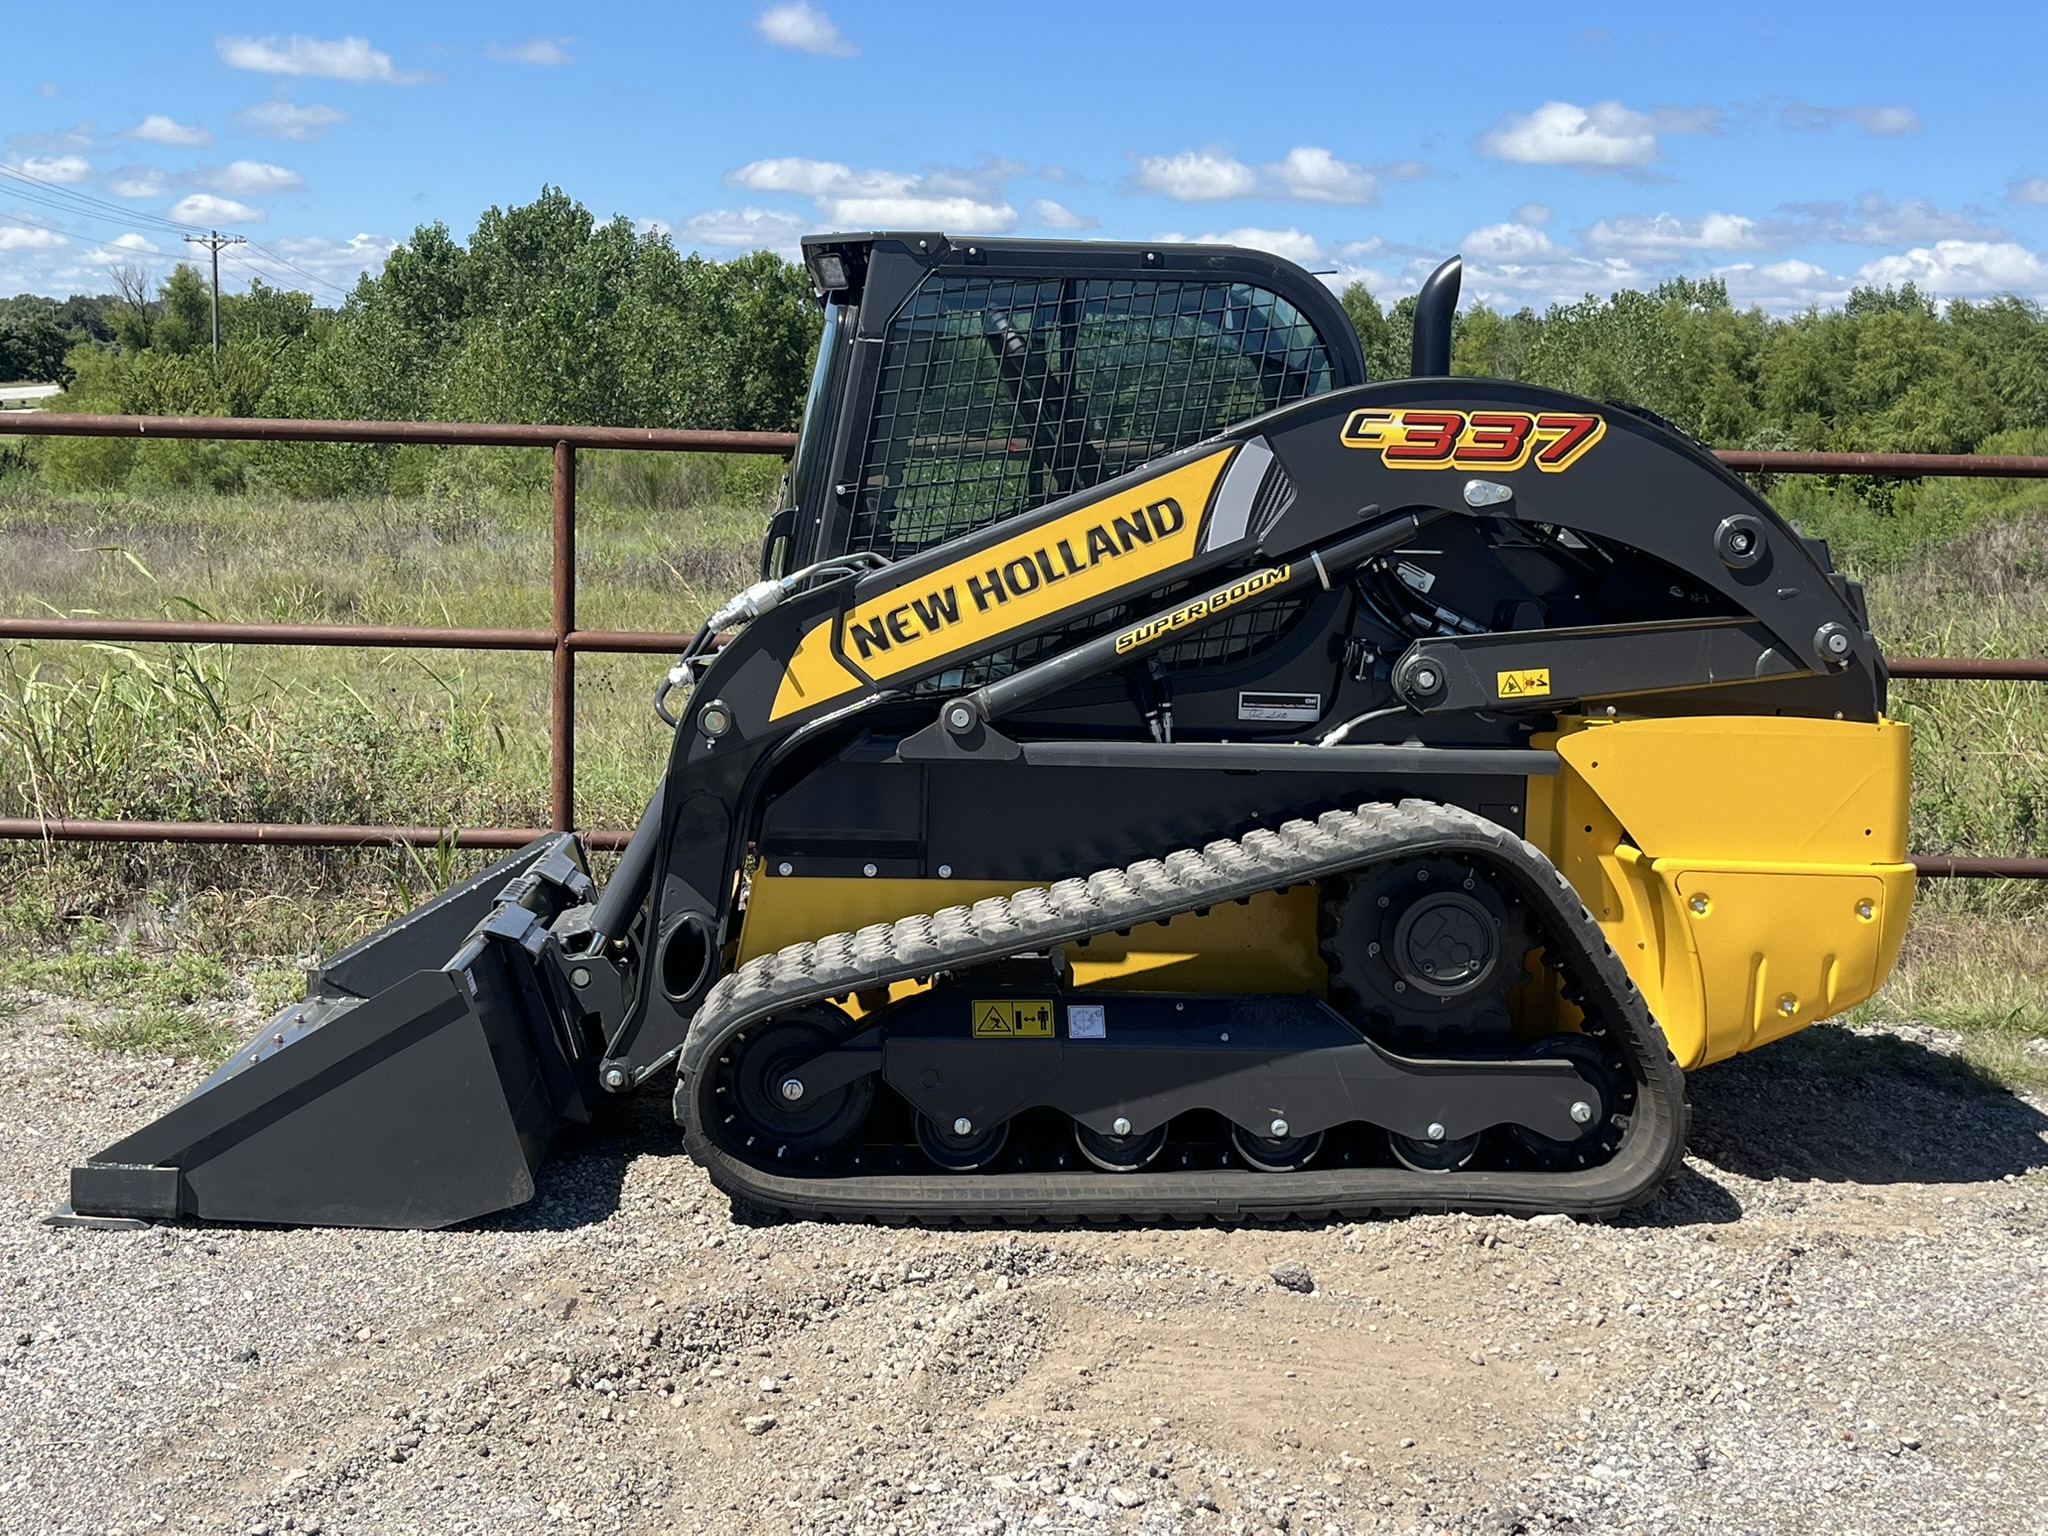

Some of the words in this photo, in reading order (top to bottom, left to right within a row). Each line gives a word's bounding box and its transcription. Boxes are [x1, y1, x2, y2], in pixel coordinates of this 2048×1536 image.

[1343, 410, 1605, 469] C337
[849, 584, 960, 661] NEW
[966, 496, 1186, 614] HOLLAND
[1116, 600, 1208, 654] SUPER
[1209, 564, 1291, 613] BOOM
